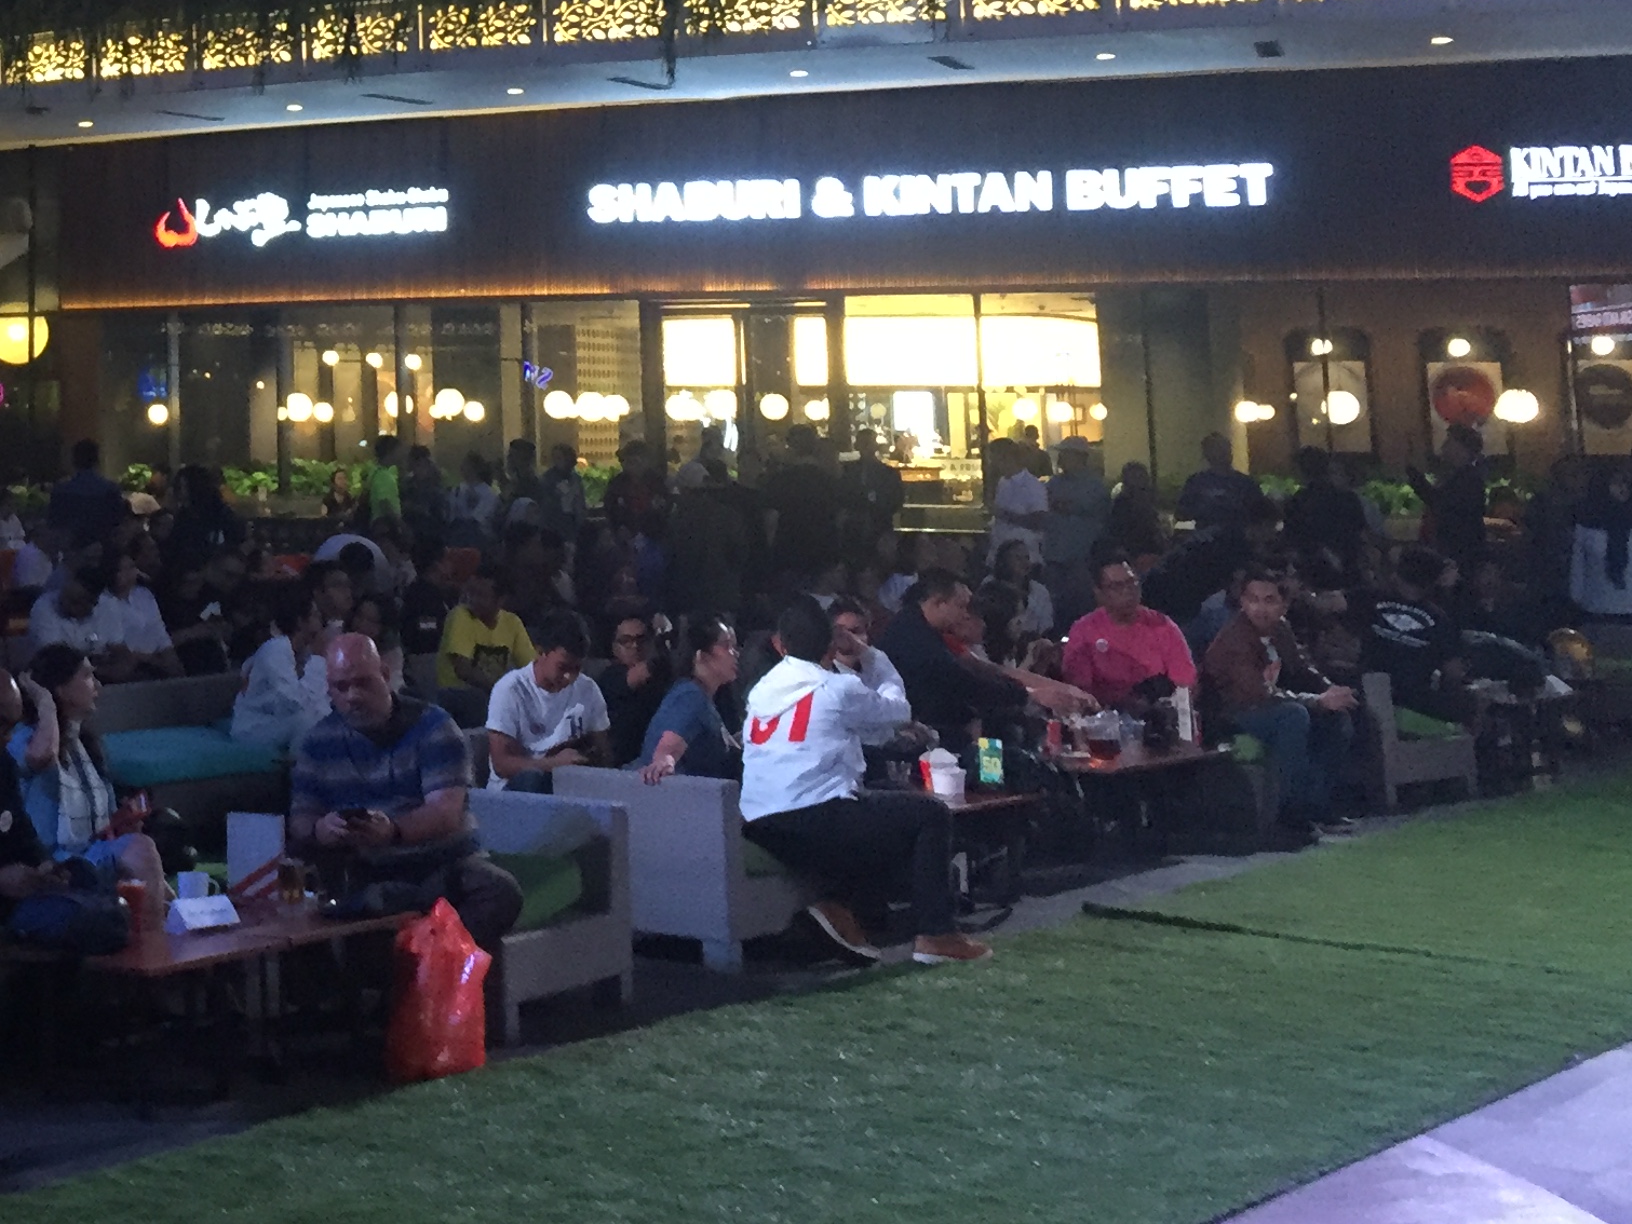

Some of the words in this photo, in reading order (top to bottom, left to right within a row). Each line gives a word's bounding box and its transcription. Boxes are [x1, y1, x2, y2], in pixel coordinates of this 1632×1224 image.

[1509, 145, 1615, 178] KINTAN
[587, 178, 801, 223] SHABURI
[811, 176, 855, 218] &
[863, 170, 1053, 216] KINTAN
[1066, 163, 1274, 211] BUFFET
